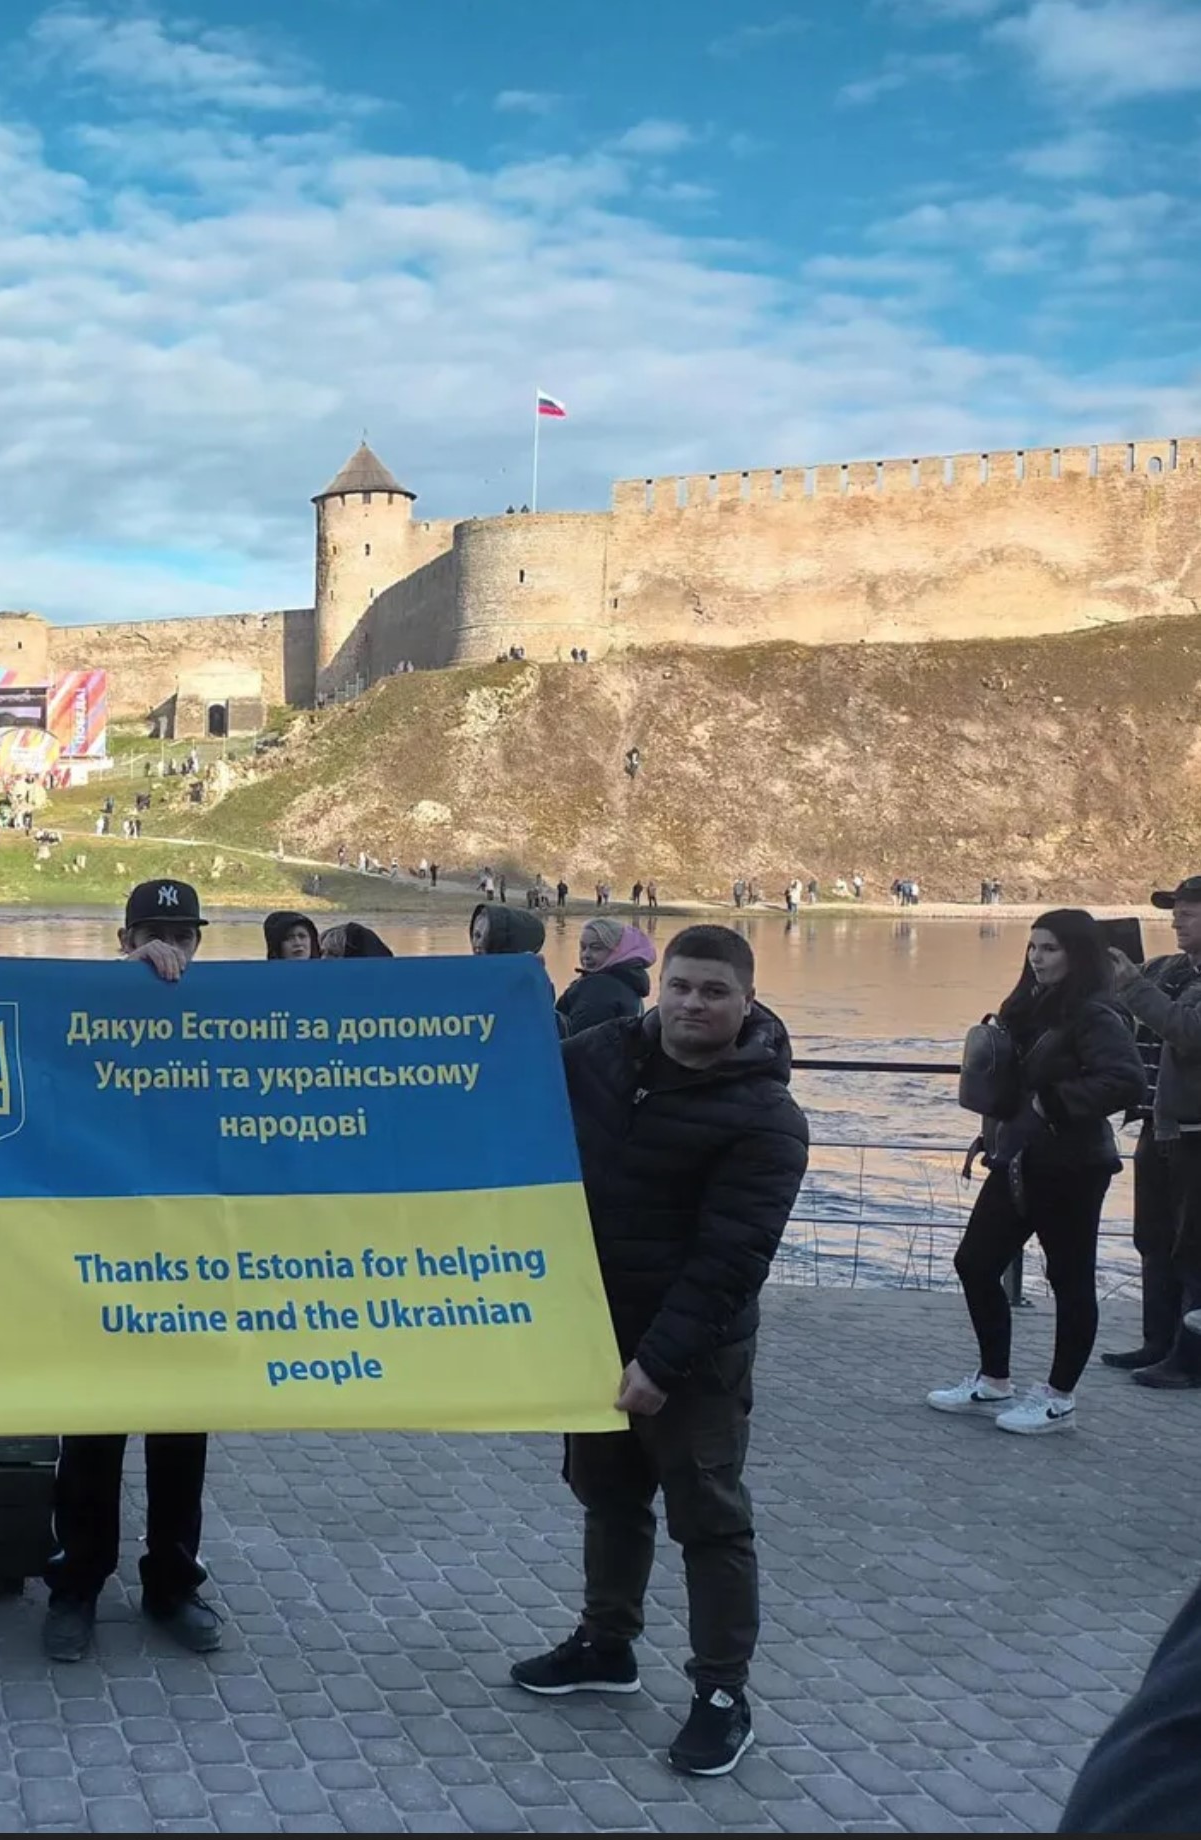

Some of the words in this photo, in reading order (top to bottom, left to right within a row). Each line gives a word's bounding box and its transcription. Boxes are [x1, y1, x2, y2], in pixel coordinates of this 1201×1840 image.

[158, 885, 179, 906] NY
[67, 1012, 173, 1047] Дякую
[182, 1012, 288, 1039] Естонії
[296, 1019, 330, 1040] за
[337, 1014, 495, 1044] допомогу
[95, 1060, 209, 1096] Україні
[216, 1068, 250, 1088] та
[257, 1060, 480, 1095] українському
[220, 1108, 367, 1144] народові
[74, 1252, 189, 1283] Thanks
[196, 1256, 229, 1281] to
[237, 1250, 354, 1281] Estonia
[361, 1248, 409, 1278] for
[416, 1245, 547, 1282] helping
[101, 1303, 227, 1334] Ukraine
[236, 1301, 297, 1331] and
[304, 1301, 359, 1330] the
[366, 1297, 533, 1329] Ukrainian
[266, 1350, 383, 1386] people
